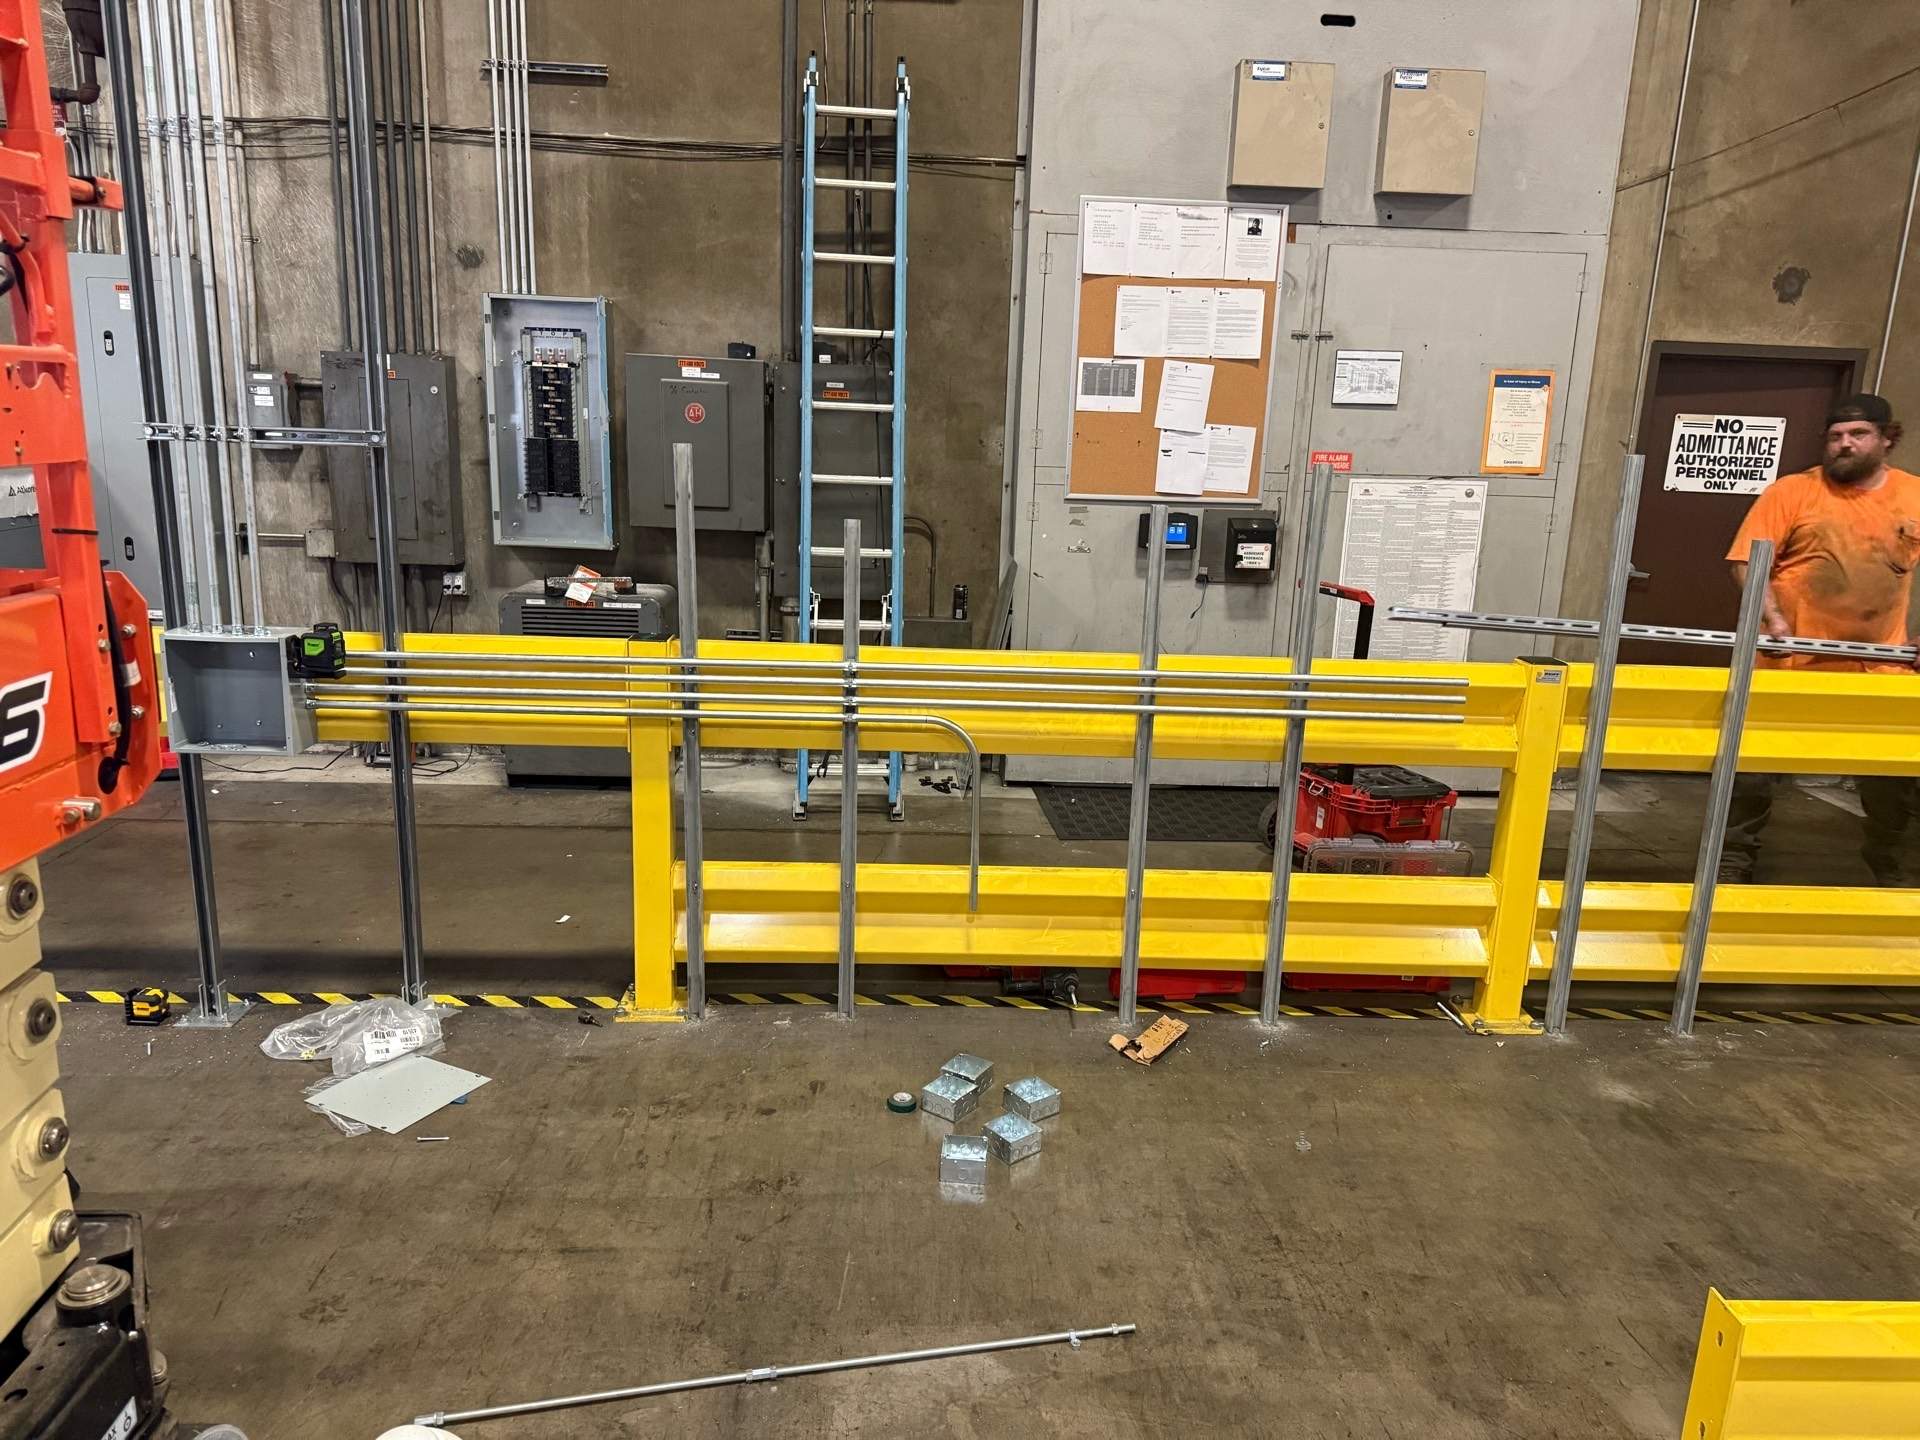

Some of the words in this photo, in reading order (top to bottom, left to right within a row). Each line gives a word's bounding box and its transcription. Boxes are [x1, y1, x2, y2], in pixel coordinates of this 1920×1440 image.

[1715, 419, 1744, 434] NO
[1676, 434, 1778, 456] ADMITTANCE
[1328, 454, 1348, 462] ALARM
[1674, 454, 1774, 469] AUTHORIZED
[1675, 466, 1767, 481] PERSONNEL
[1704, 480, 1737, 491] ONLY
[0, 675, 50, 770] 6
